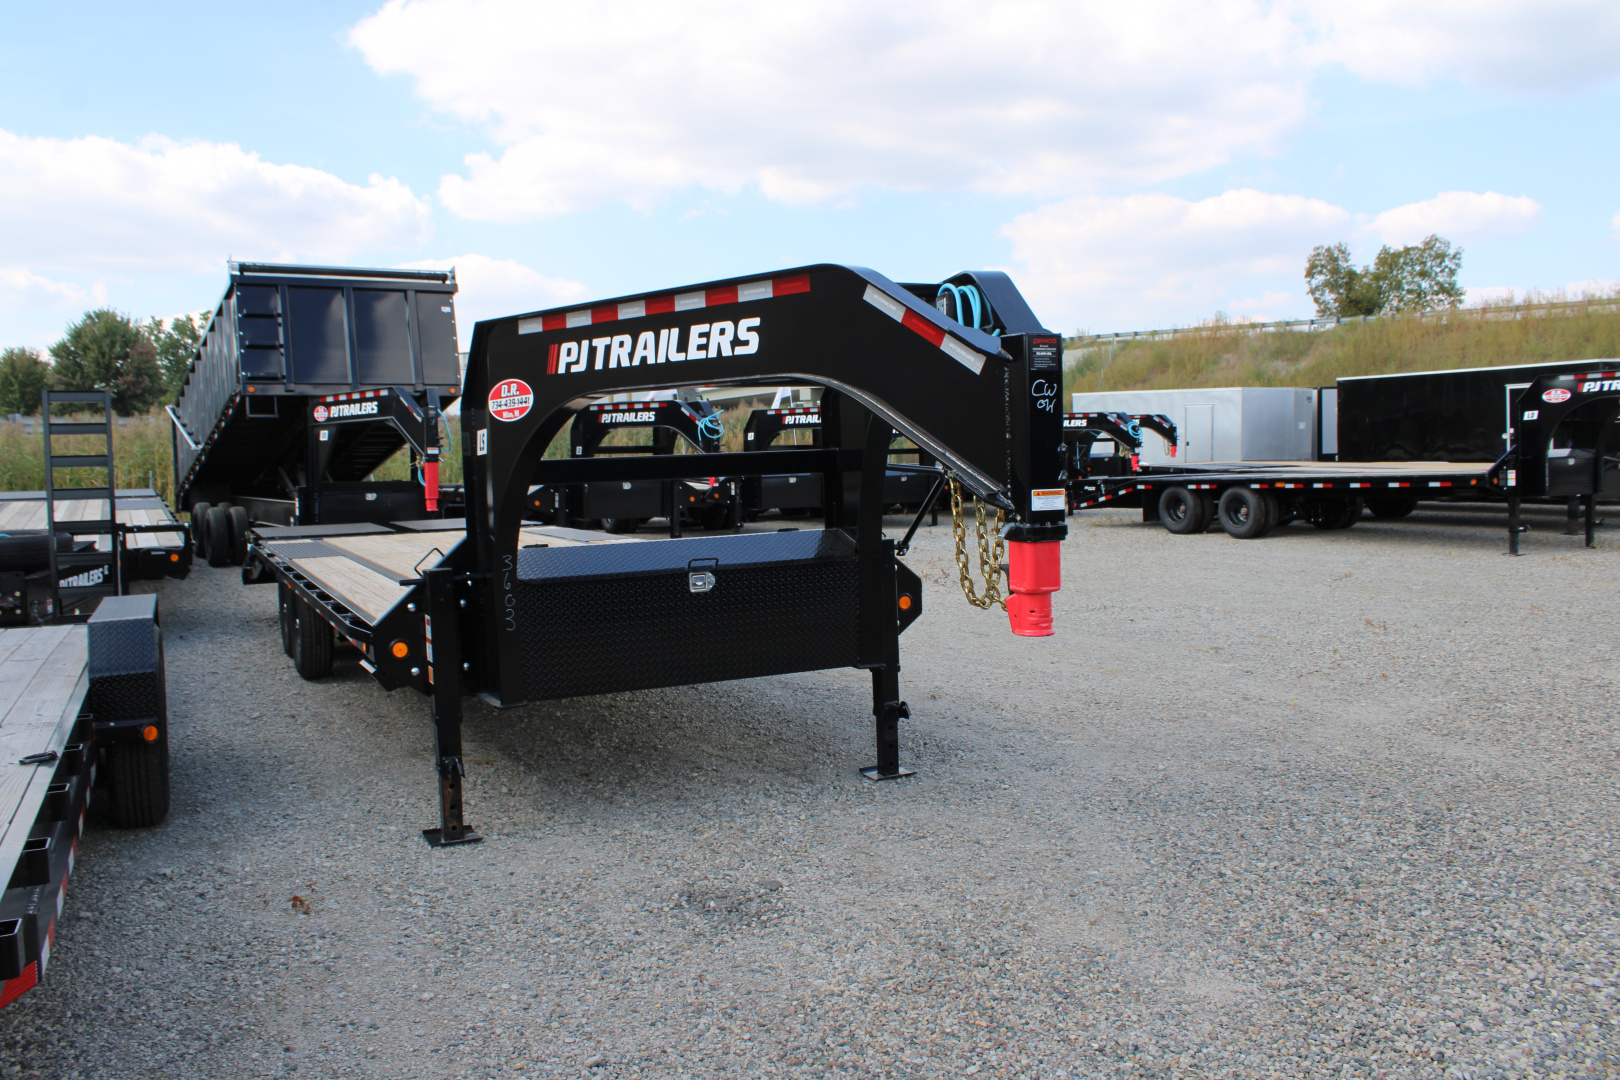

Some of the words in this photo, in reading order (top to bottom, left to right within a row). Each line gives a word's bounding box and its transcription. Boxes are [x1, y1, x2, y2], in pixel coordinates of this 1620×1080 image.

[557, 339, 588, 375] PJ
[594, 316, 762, 371] TRAILERS
[501, 382, 520, 398] D.R.
[339, 401, 379, 417] TRAILERS
[491, 396, 530, 410] 734-439-1441
[612, 411, 656, 423] TRAILERS
[795, 414, 822, 424] TRAIL
